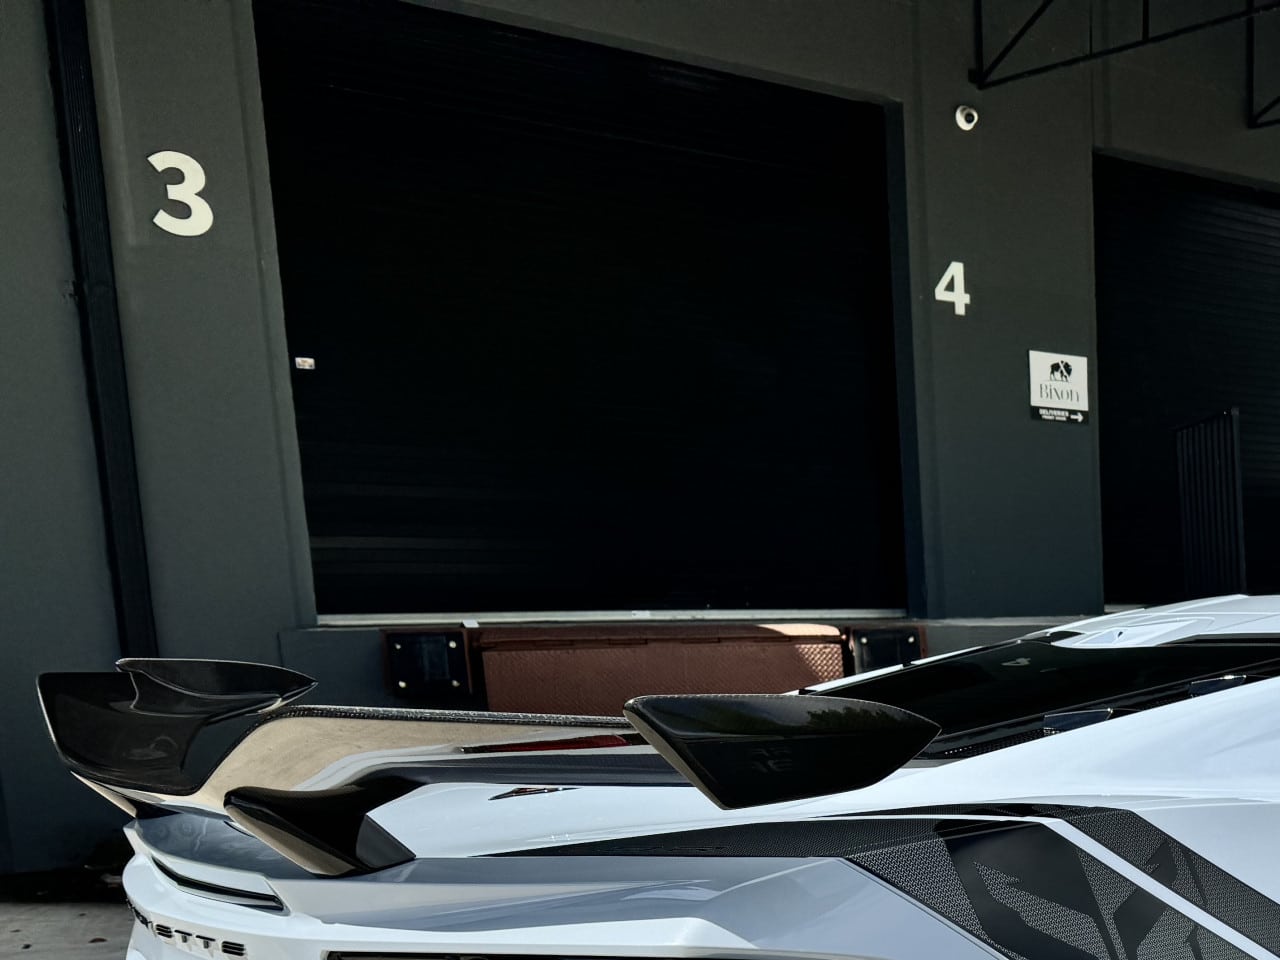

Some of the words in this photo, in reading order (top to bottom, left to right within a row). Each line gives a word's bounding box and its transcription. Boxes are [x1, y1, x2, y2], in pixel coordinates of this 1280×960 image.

[146, 150, 214, 237] 3
[934, 260, 971, 316] 4
[127, 899, 247, 957] ETTE
